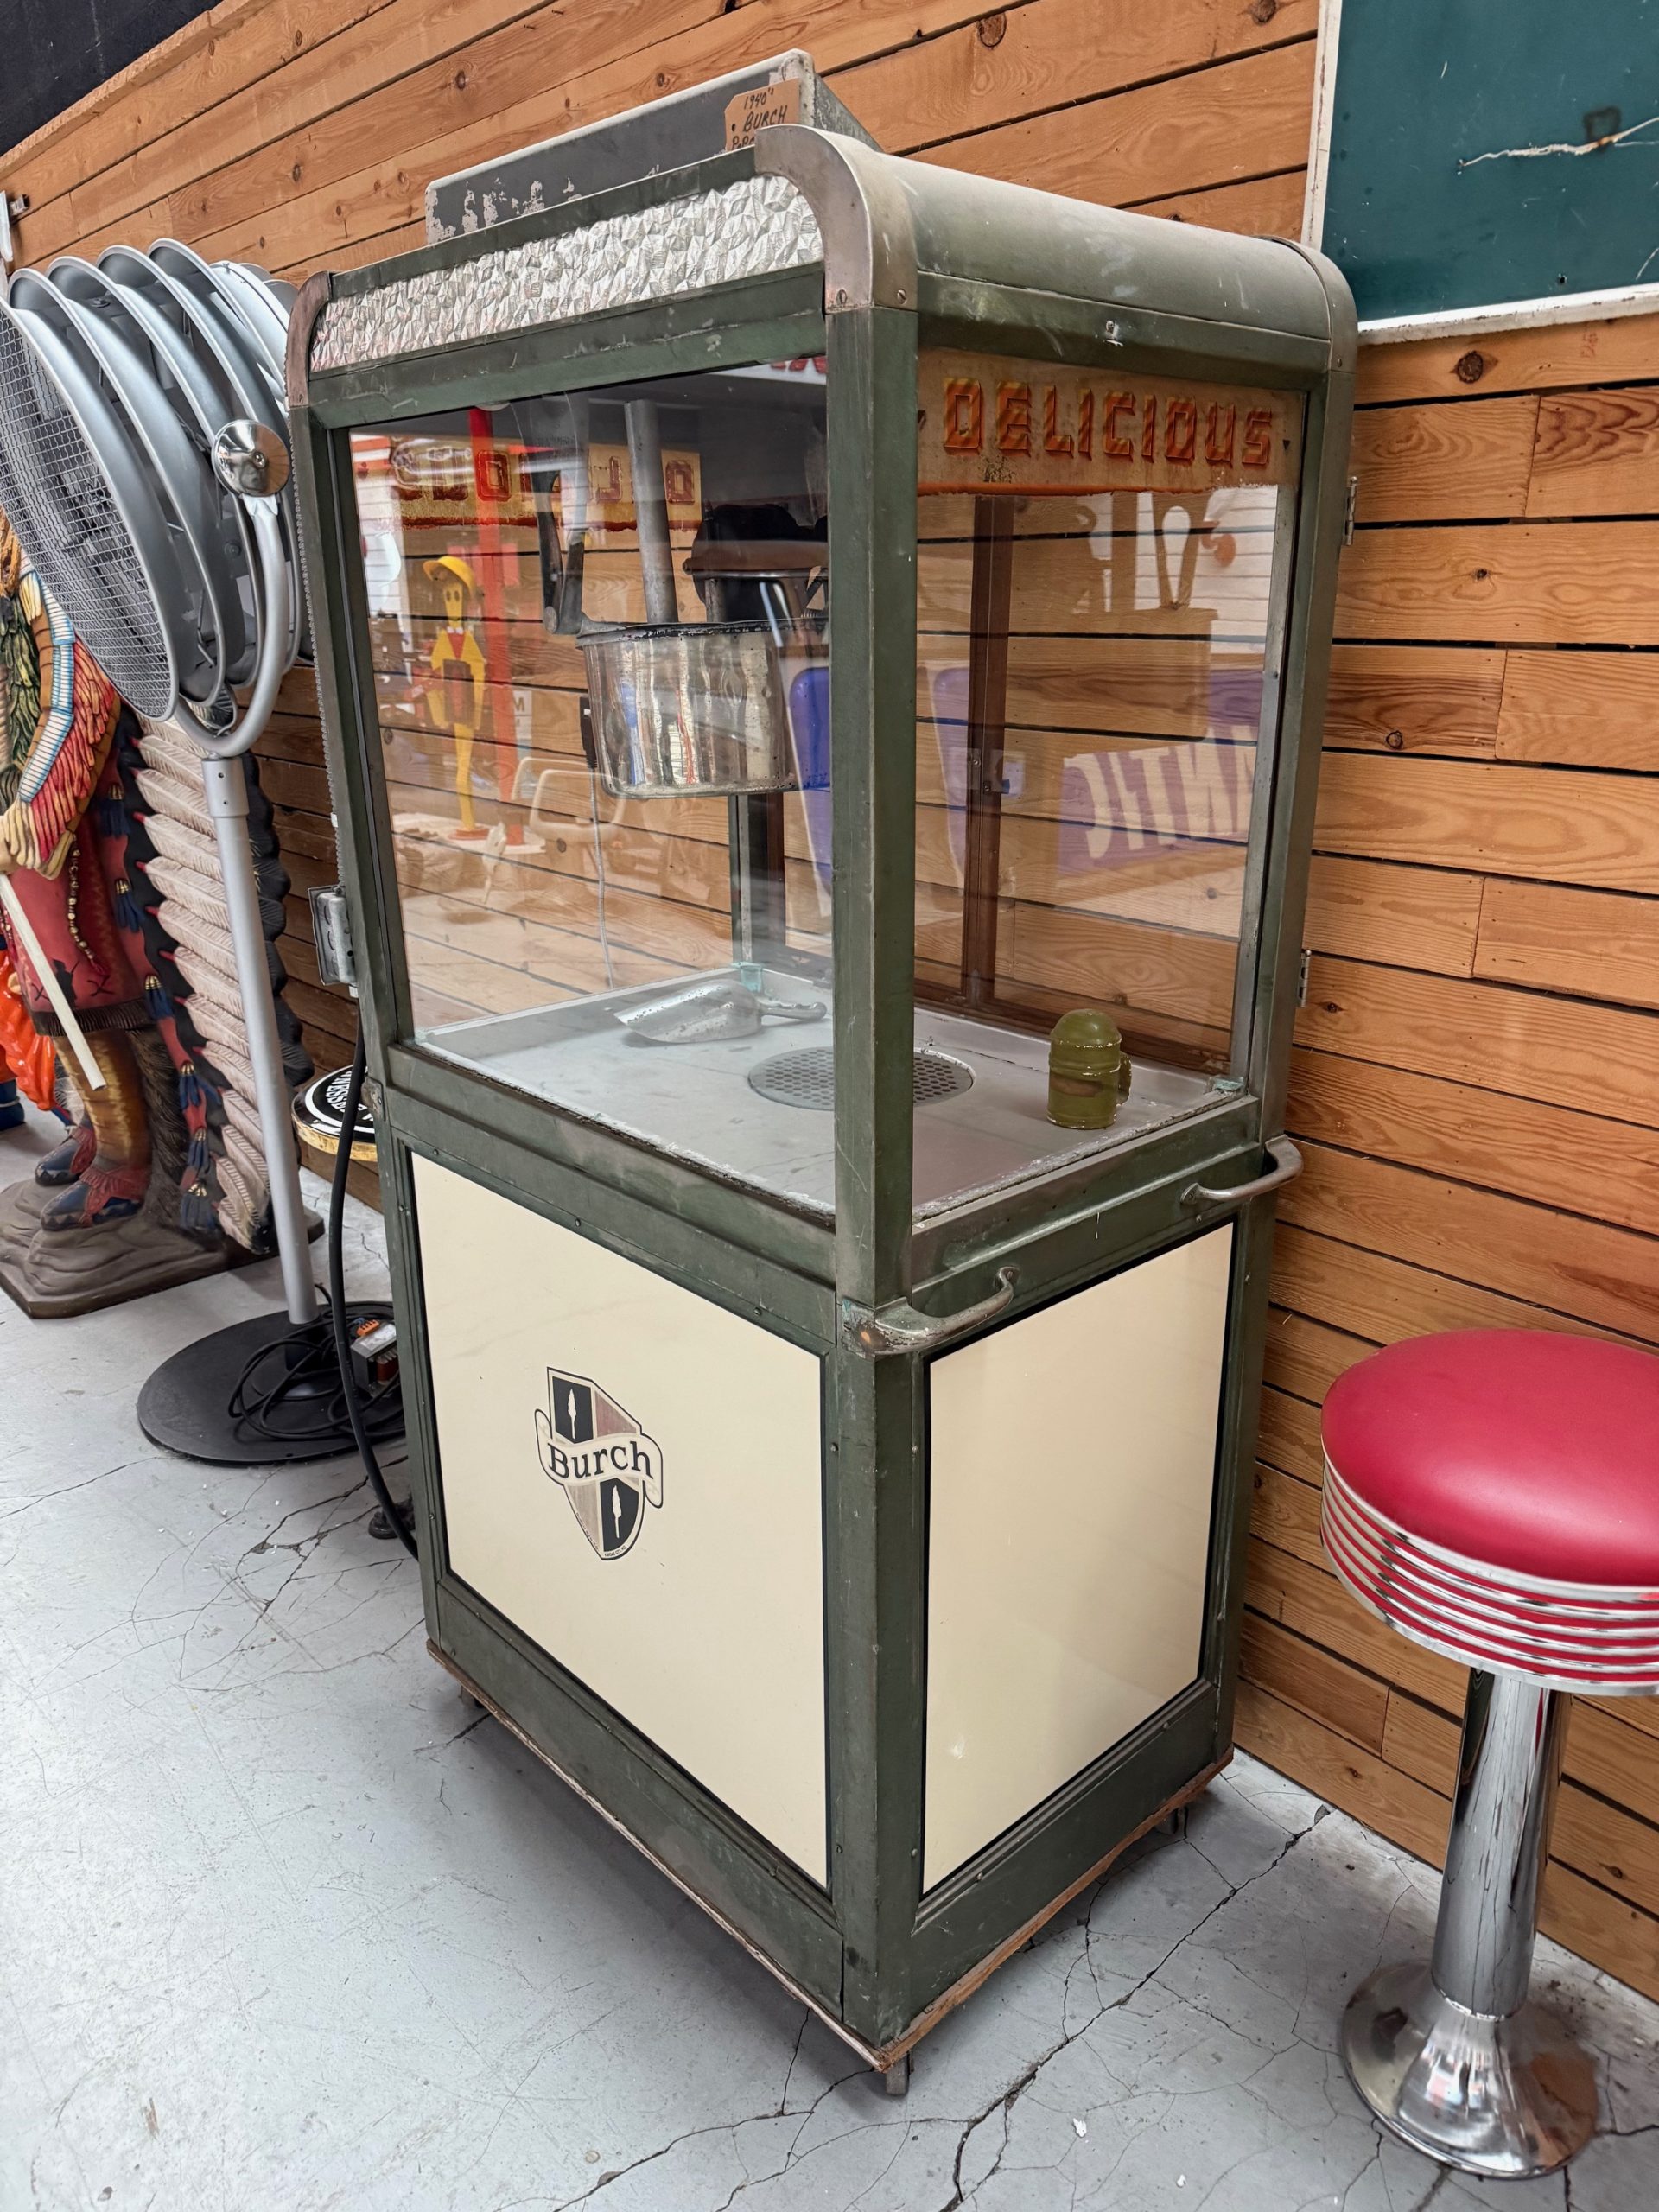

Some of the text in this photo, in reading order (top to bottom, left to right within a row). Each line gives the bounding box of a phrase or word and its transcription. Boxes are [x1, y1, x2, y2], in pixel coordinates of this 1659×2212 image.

[742, 105, 788, 133] BURCH
[943, 377, 1273, 468] DELICIOUS
[546, 1440, 654, 1480] Burch
